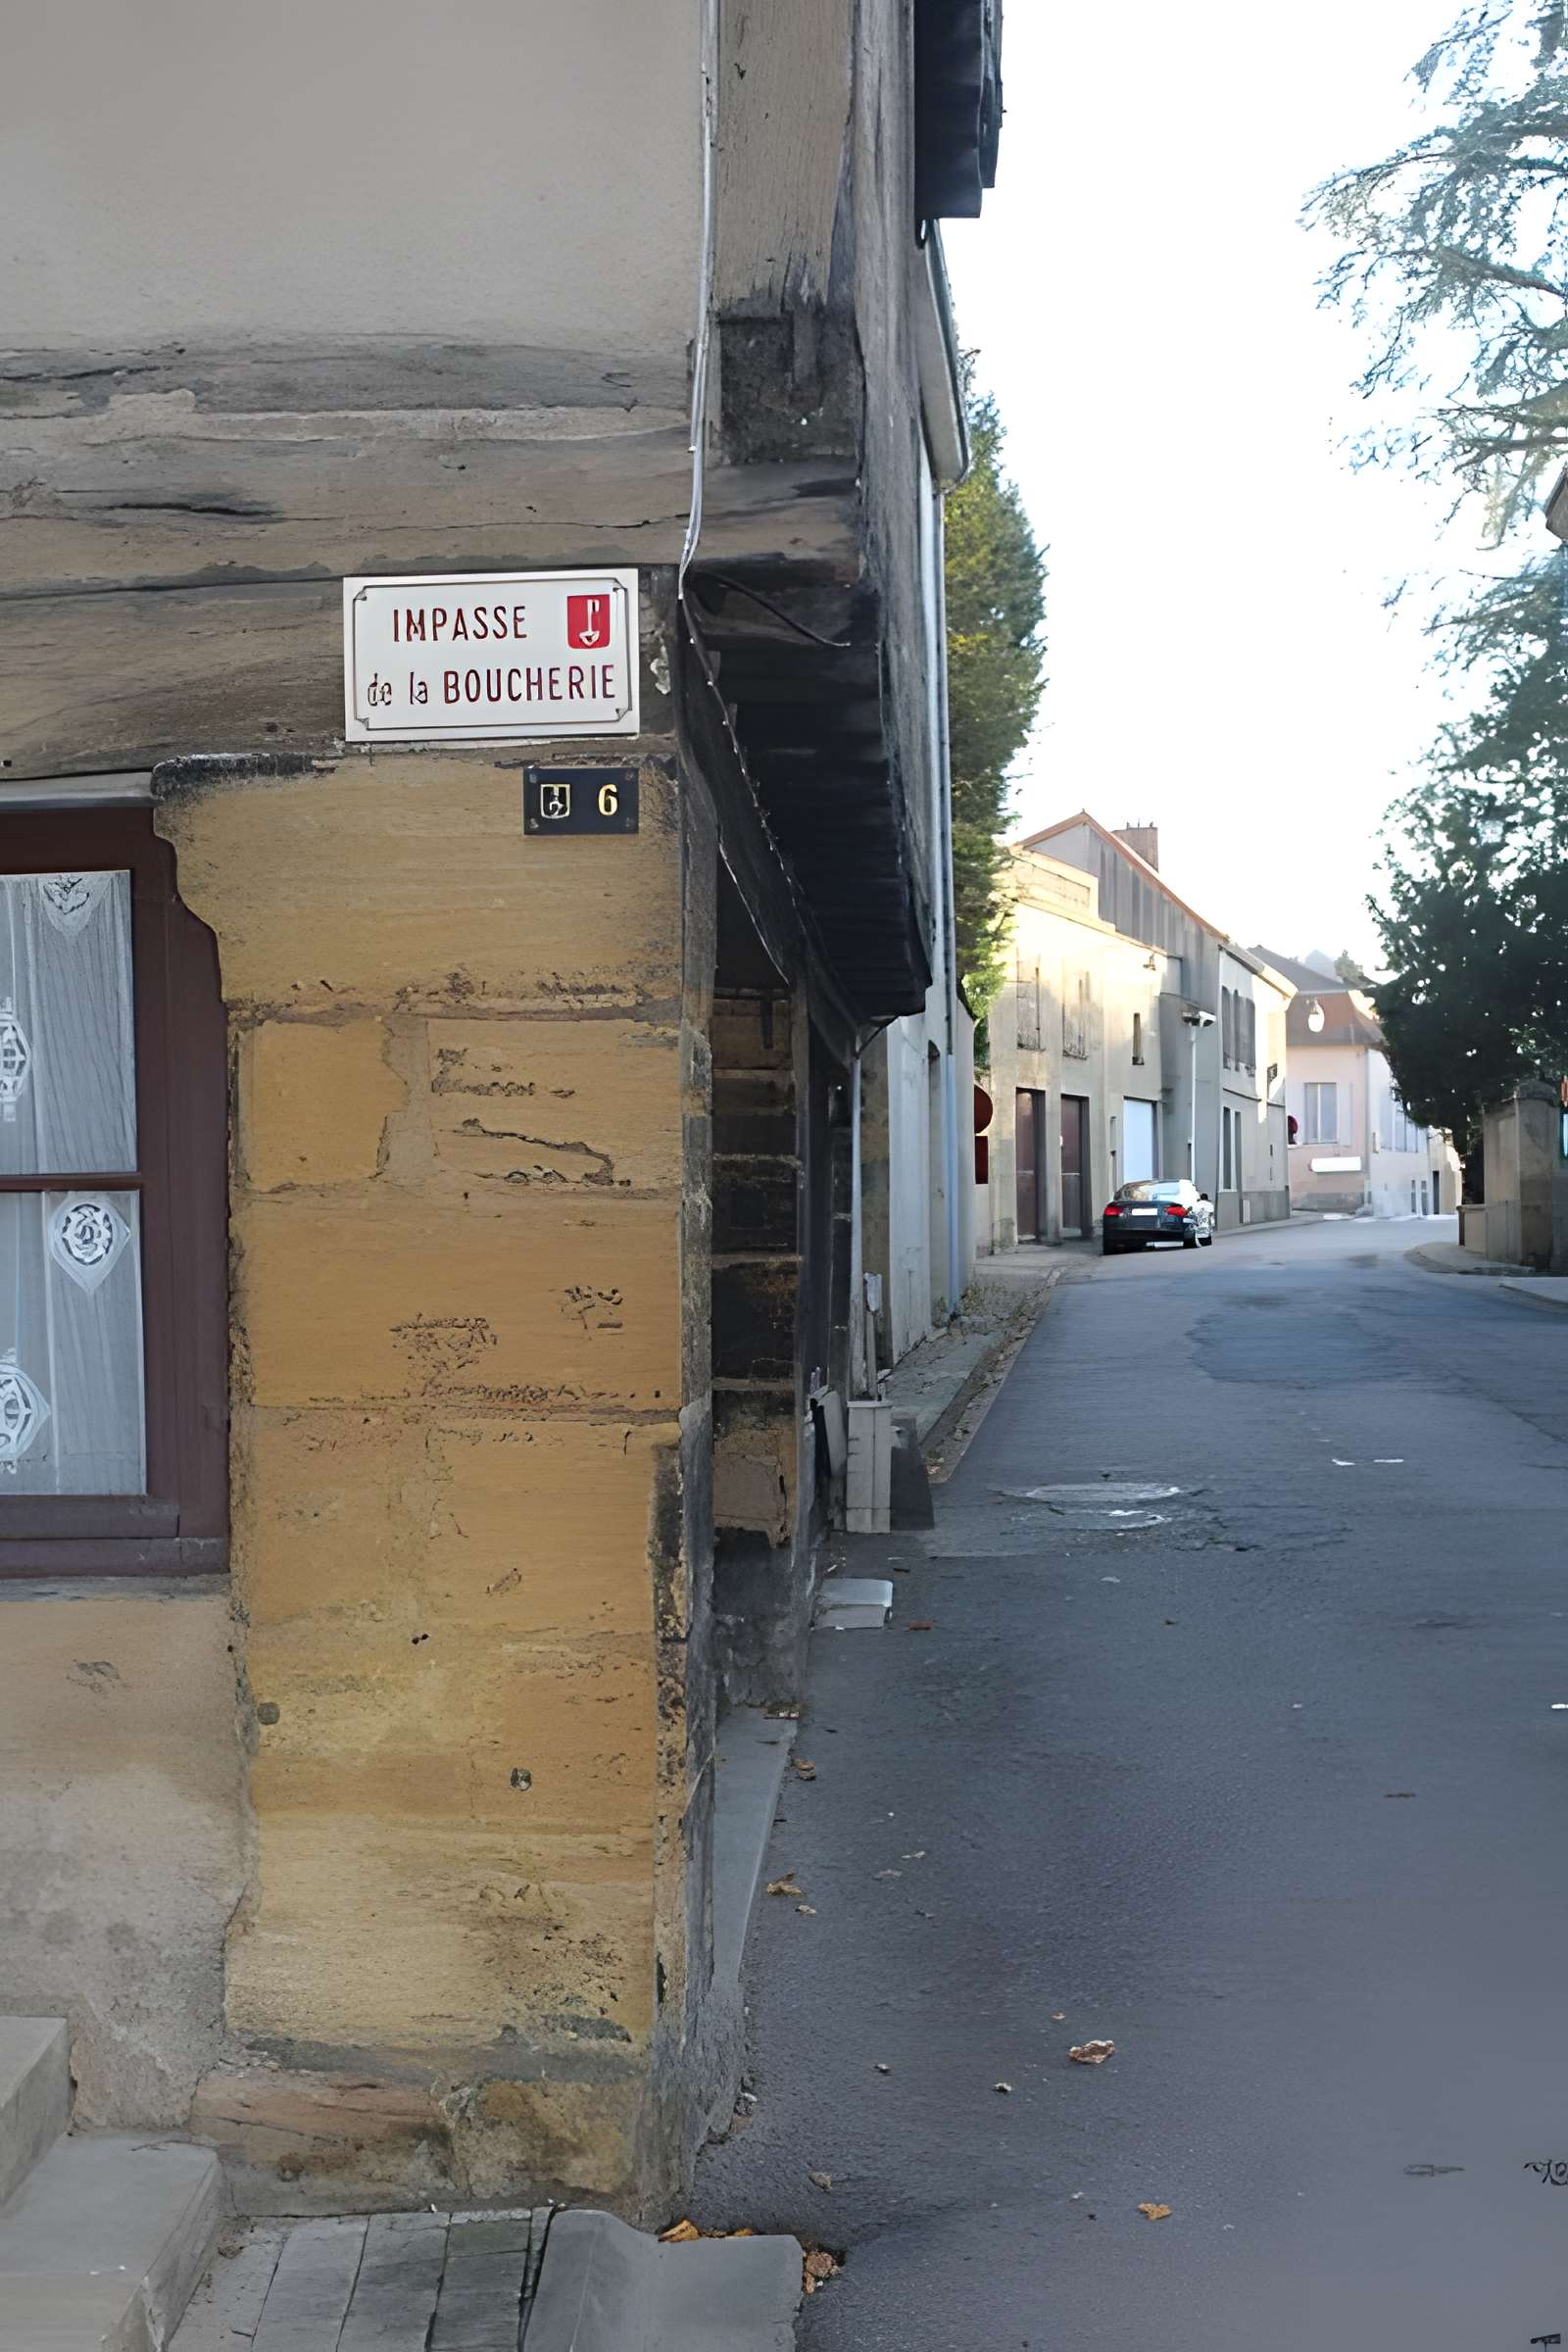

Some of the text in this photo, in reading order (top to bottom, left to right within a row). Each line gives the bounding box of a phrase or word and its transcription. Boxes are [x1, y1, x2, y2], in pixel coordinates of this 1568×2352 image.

[393, 606, 527, 642] IMPASSE
[367, 664, 615, 706] de la BOUCHERIE
[598, 783, 618, 816] 6
